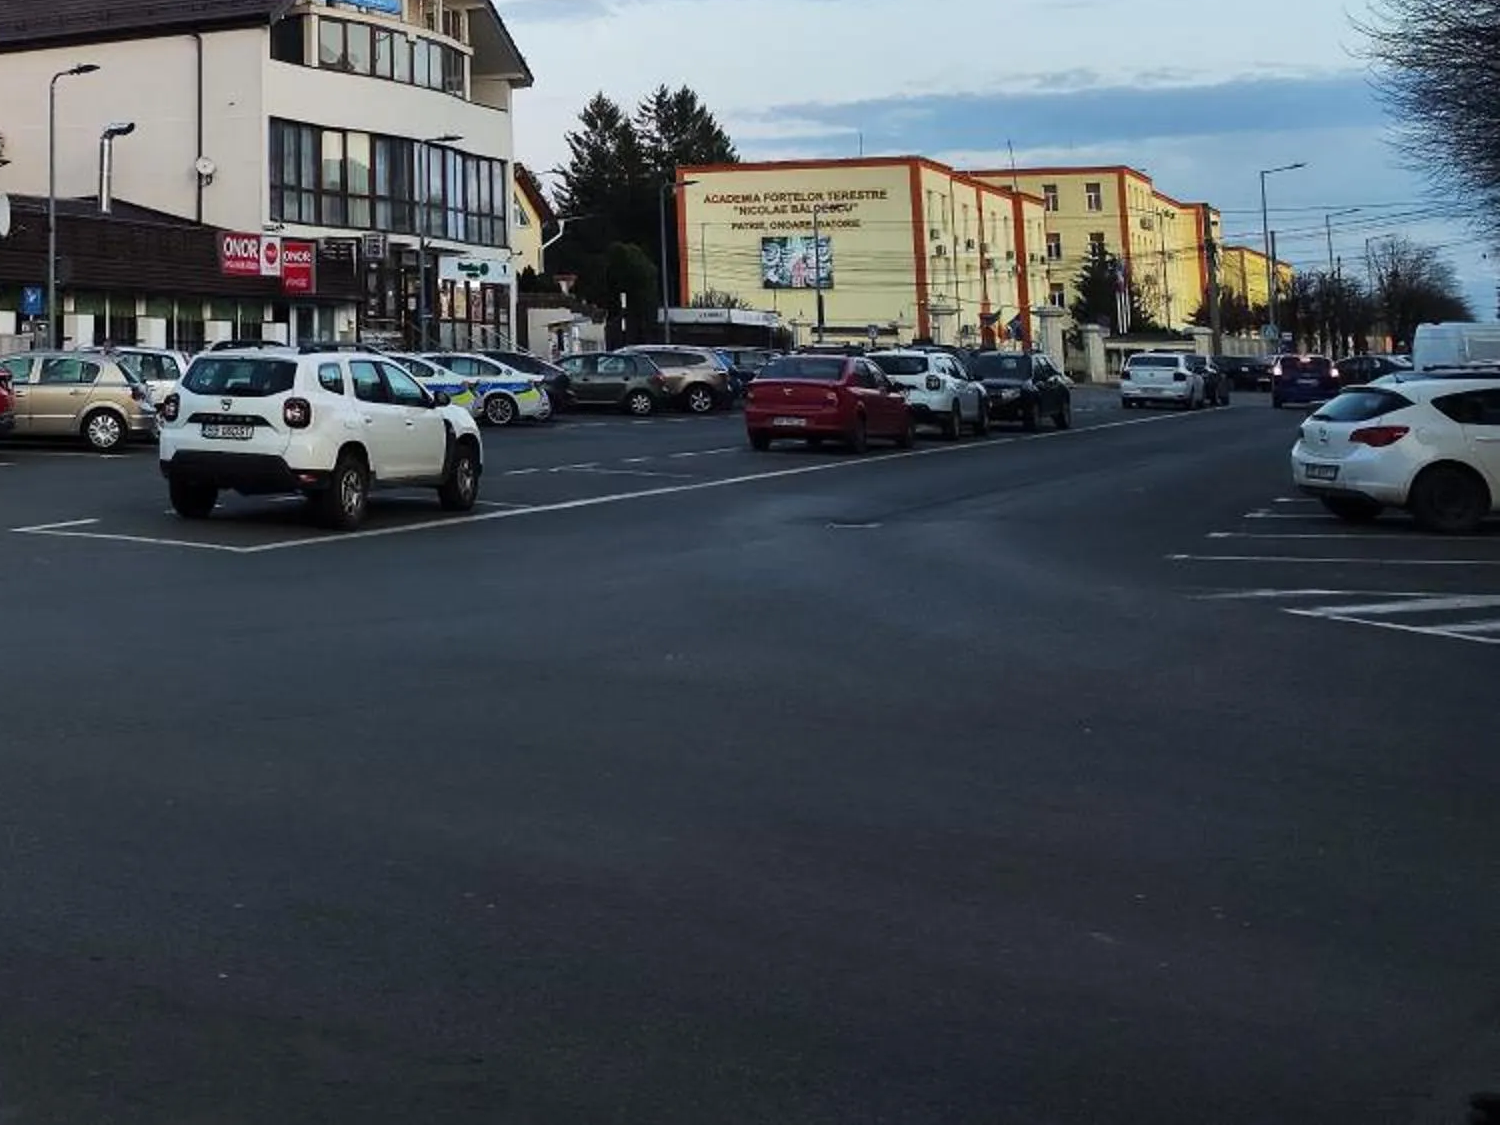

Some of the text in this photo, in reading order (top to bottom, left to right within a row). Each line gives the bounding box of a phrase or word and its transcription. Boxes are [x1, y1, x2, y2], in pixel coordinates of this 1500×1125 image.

[704, 193, 761, 204] ACADEMIA
[827, 189, 888, 201] TERESTRE
[223, 237, 259, 259] ONOR
